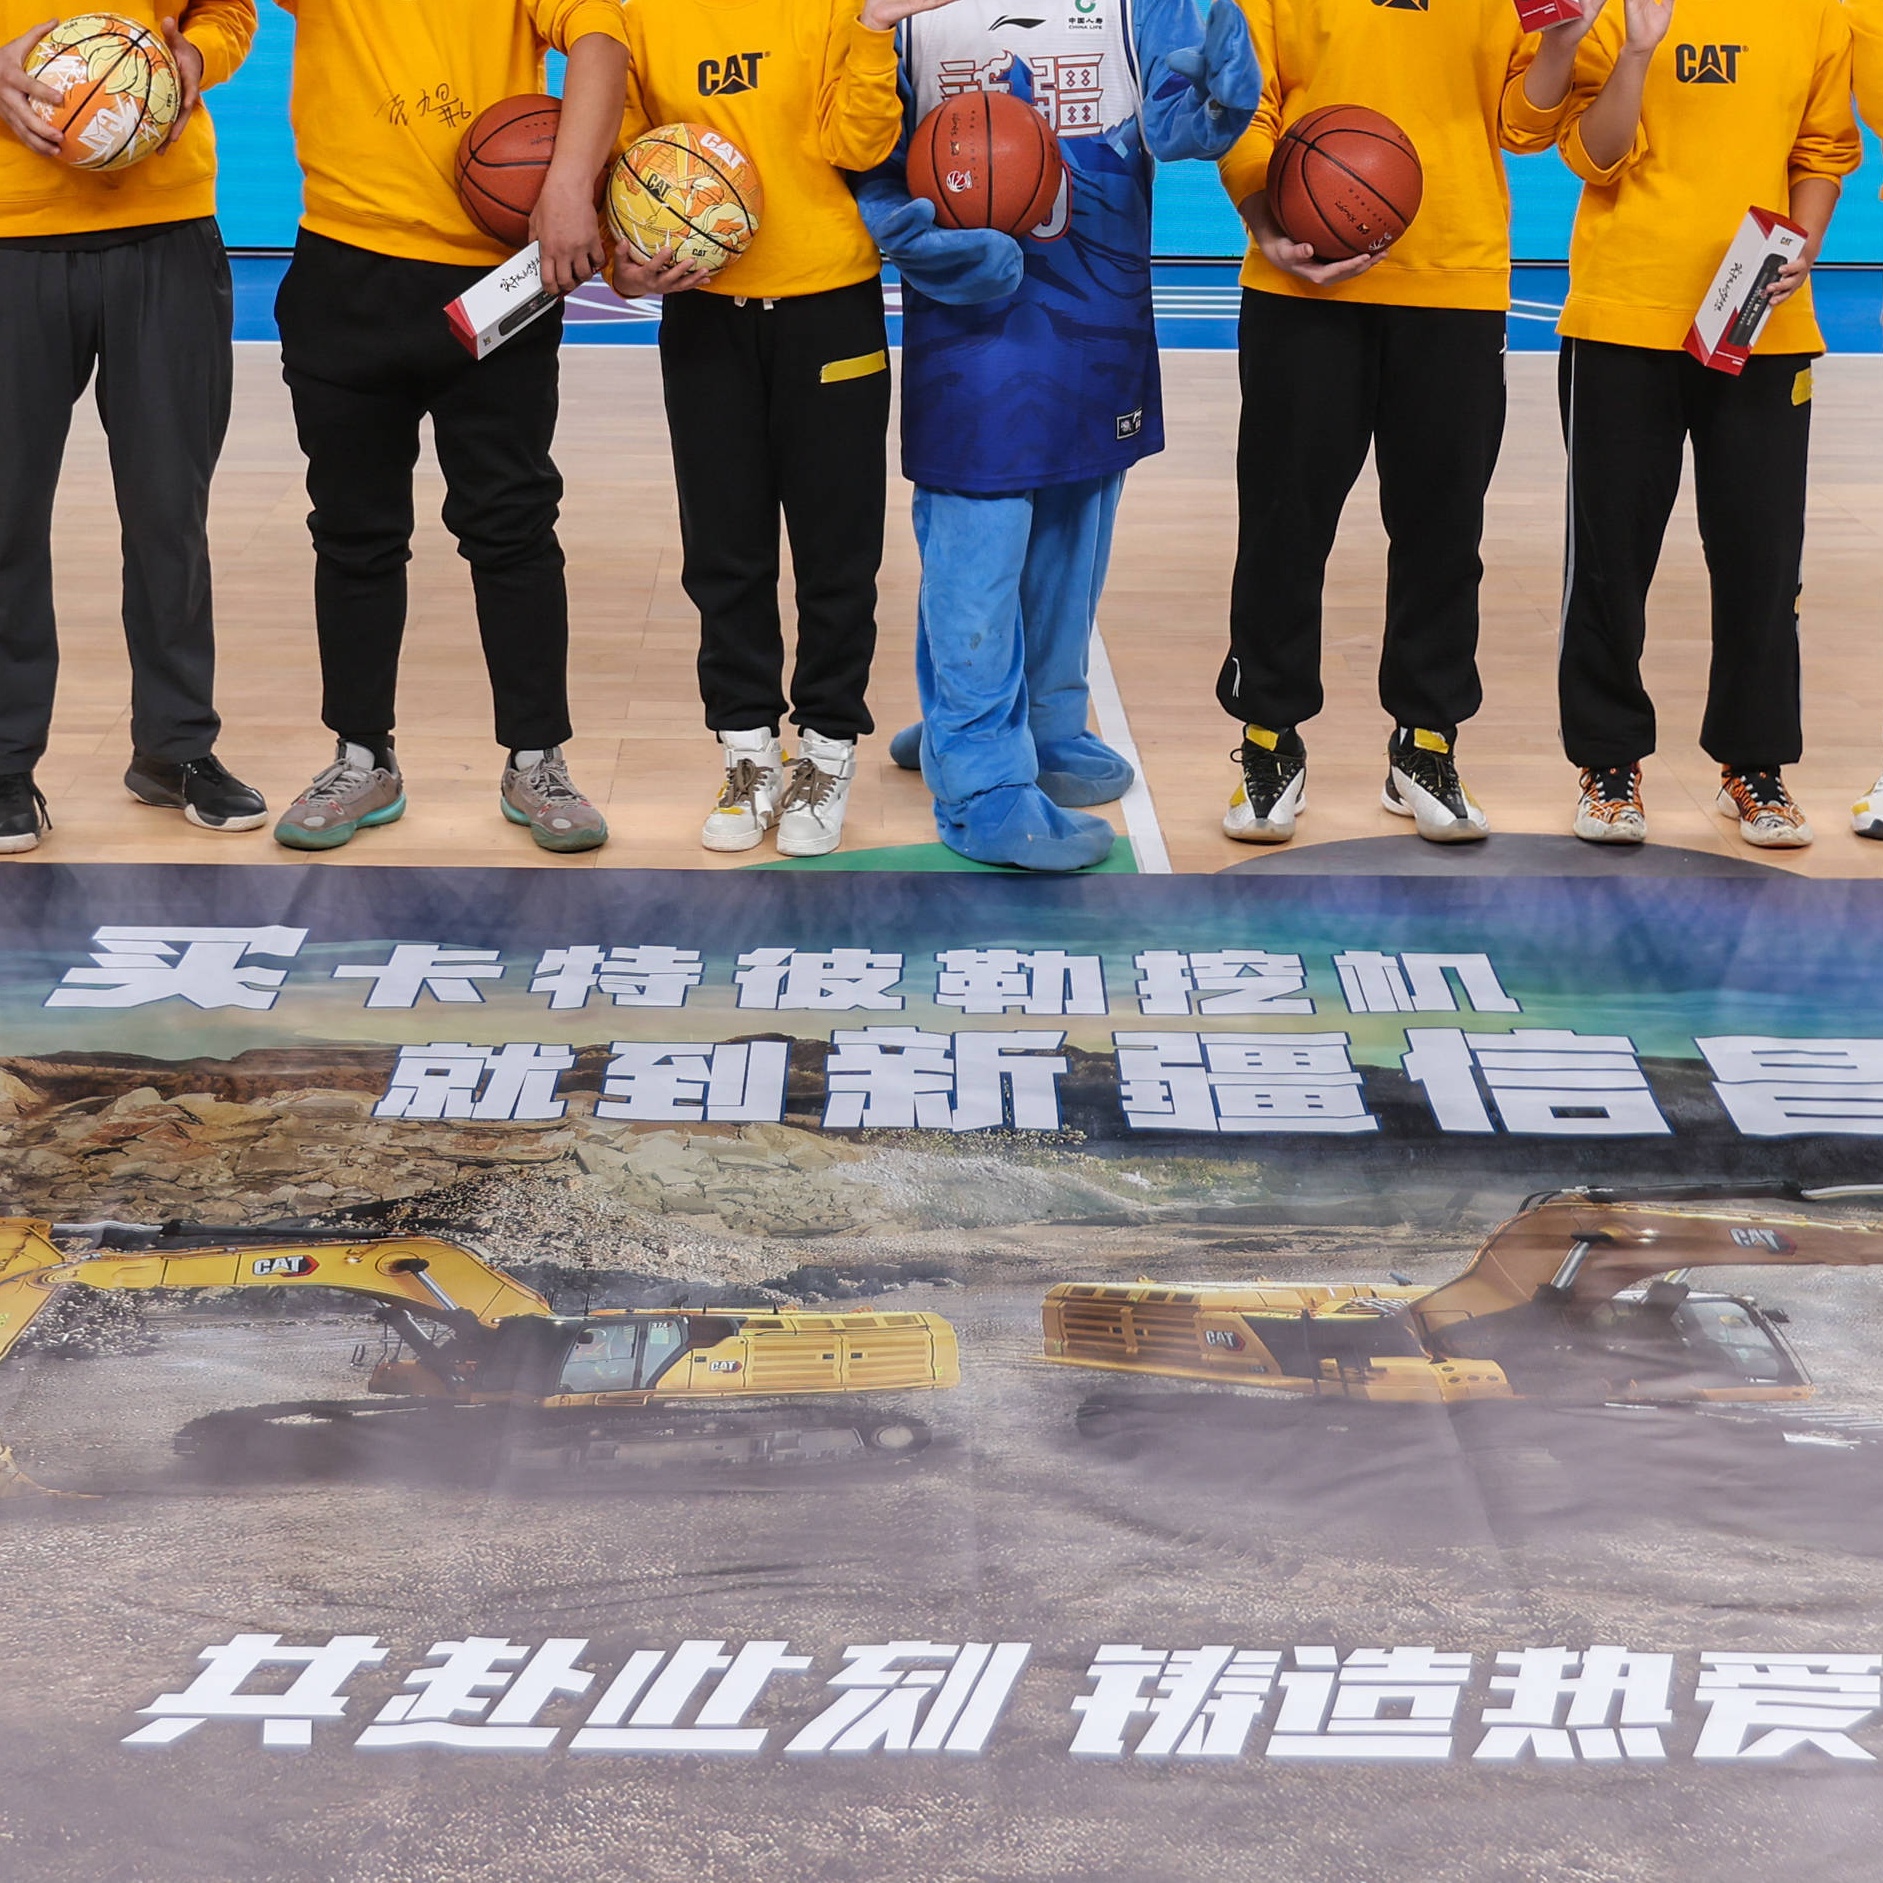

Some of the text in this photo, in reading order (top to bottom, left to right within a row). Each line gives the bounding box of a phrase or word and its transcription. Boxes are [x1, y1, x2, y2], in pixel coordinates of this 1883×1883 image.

[698, 52, 764, 97] CAT
[1675, 43, 1741, 84] CAT
[43, 923, 1523, 1015] 买卡特彼勒挖机
[1729, 1228, 1780, 1250] CAT
[252, 1255, 304, 1276] CAT
[119, 1633, 1883, 1761] 共赴此刻 铸造热爱
